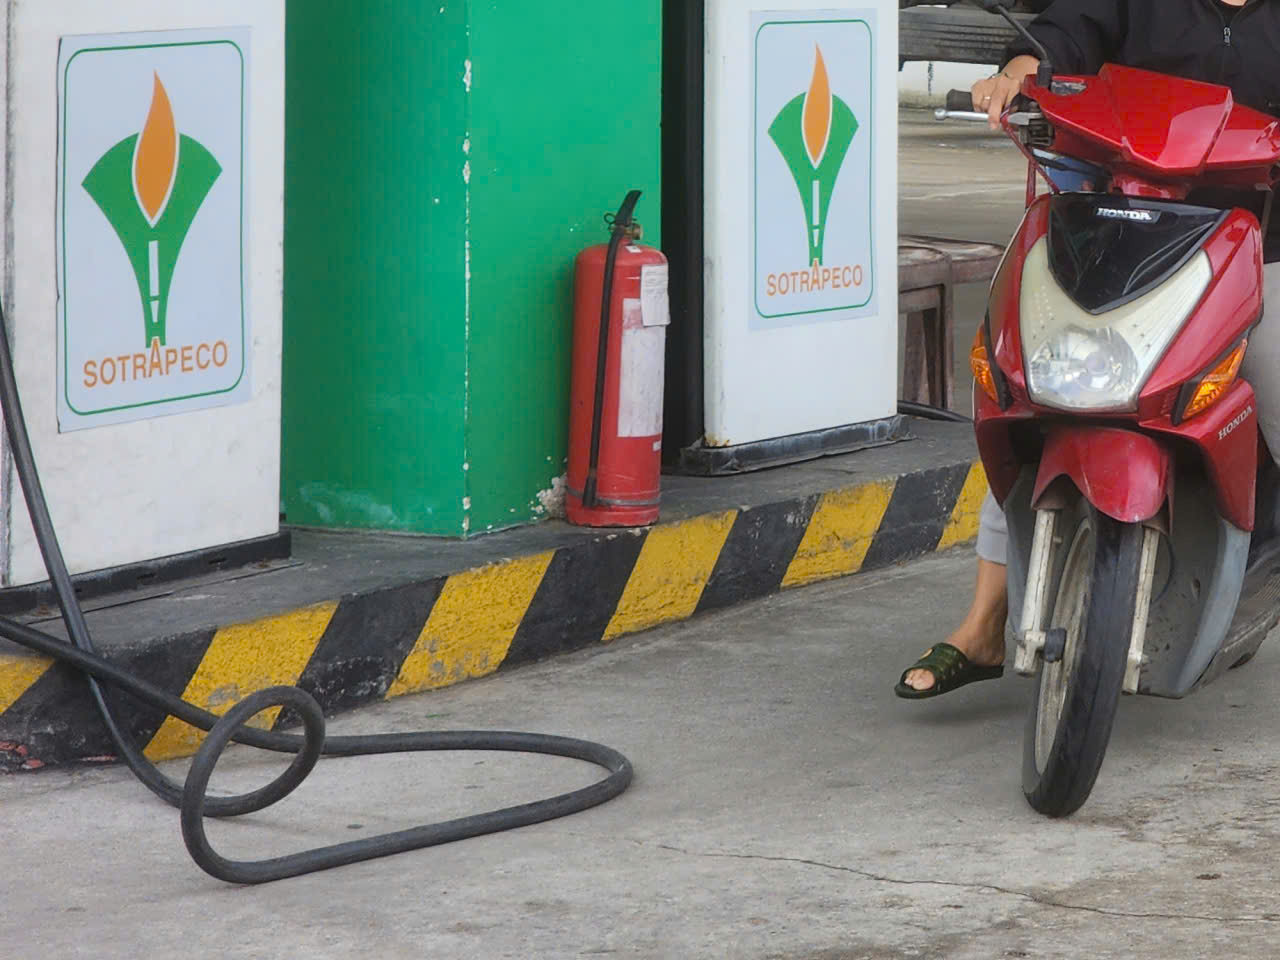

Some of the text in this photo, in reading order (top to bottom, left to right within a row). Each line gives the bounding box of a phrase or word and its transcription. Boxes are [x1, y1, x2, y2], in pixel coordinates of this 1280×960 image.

[1097, 207, 1152, 221] HONDA
[766, 258, 863, 297] SOTRAPECO
[83, 338, 229, 388] SOTRAPECO
[1218, 405, 1252, 440] HONDA
